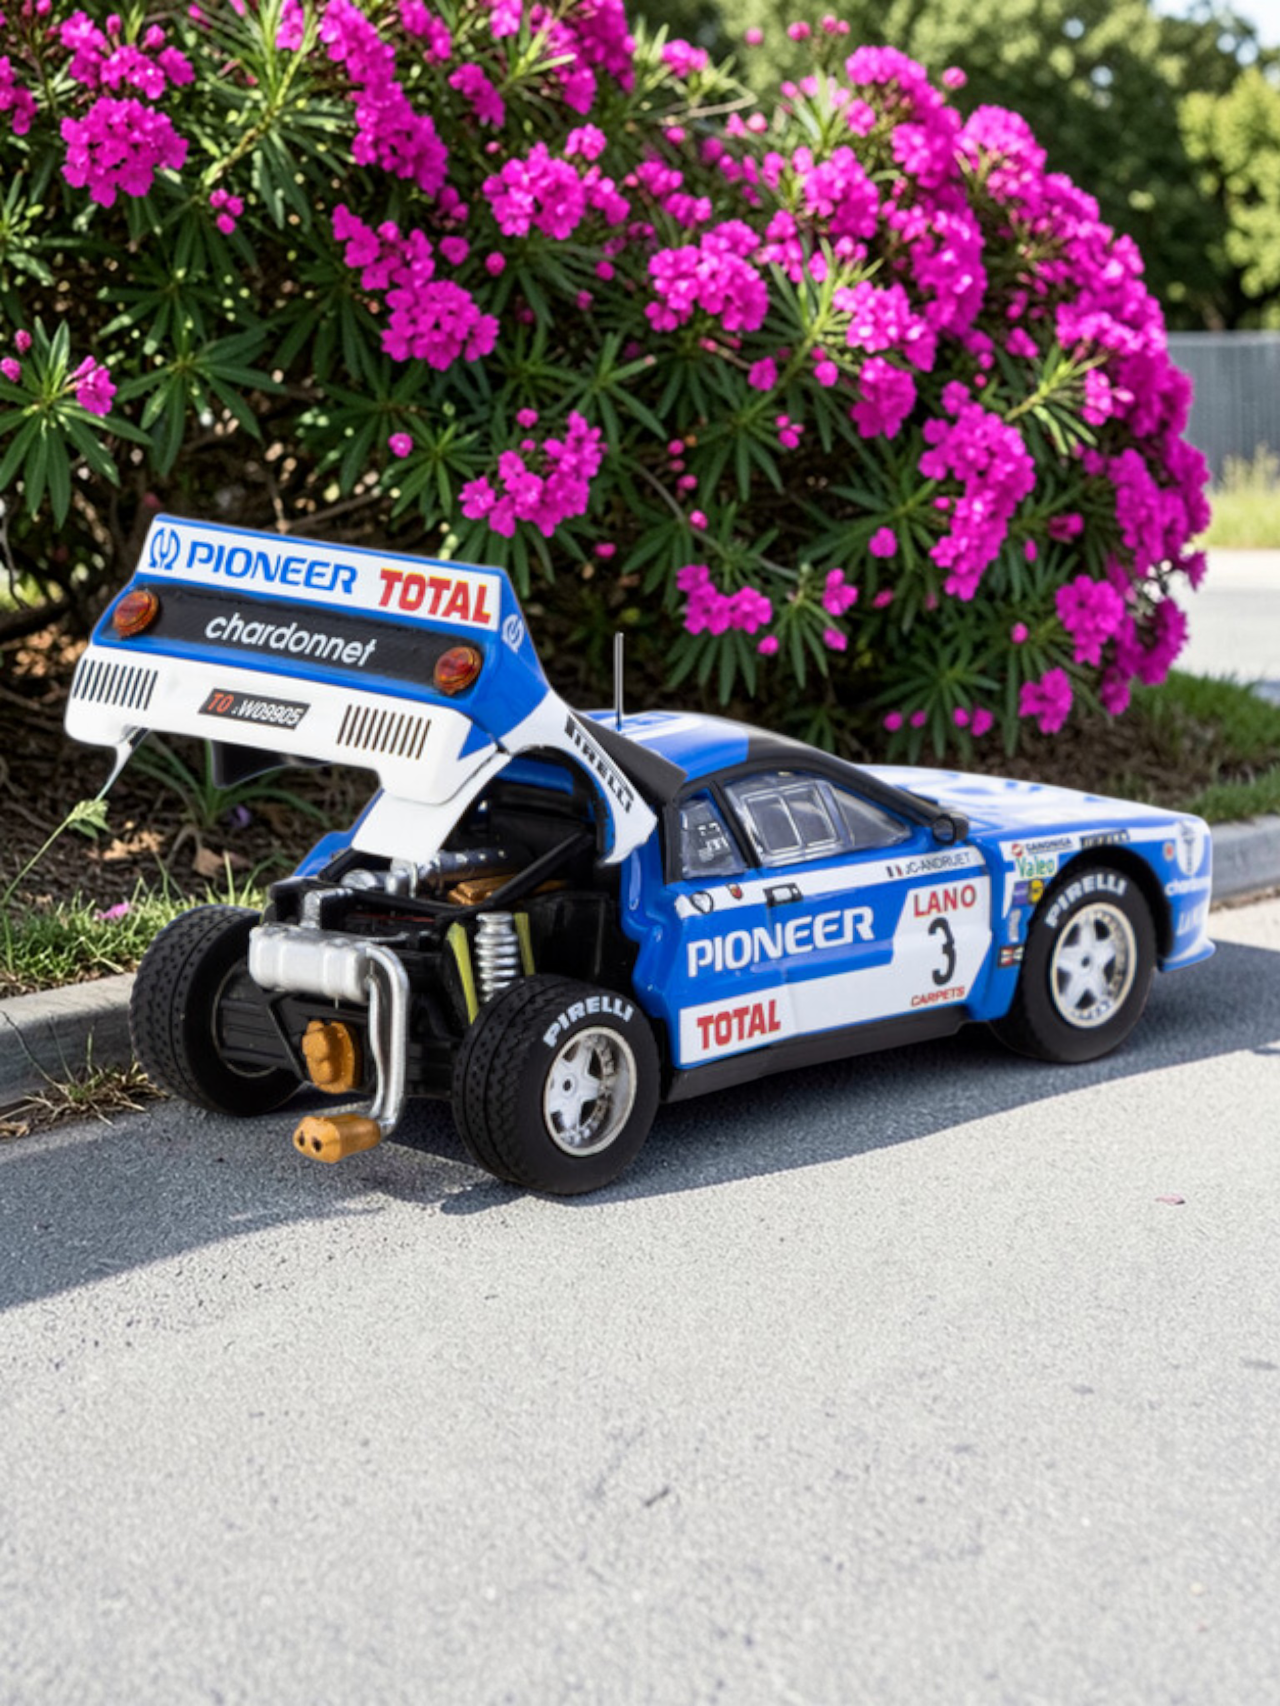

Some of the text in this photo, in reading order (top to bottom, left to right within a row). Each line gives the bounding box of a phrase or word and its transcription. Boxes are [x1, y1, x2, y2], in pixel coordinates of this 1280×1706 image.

[187, 540, 491, 624] PIONEER TOTAL
[204, 612, 377, 668] chardonnet
[913, 884, 977, 918] LANO
[1044, 874, 1128, 928] PIRELLI
[687, 906, 875, 978] PIONEER
[928, 917, 957, 987] 3
[542, 995, 634, 1048] PIRELLI
[910, 986, 966, 1008] CARPETS
[697, 999, 781, 1051] TOTAL
